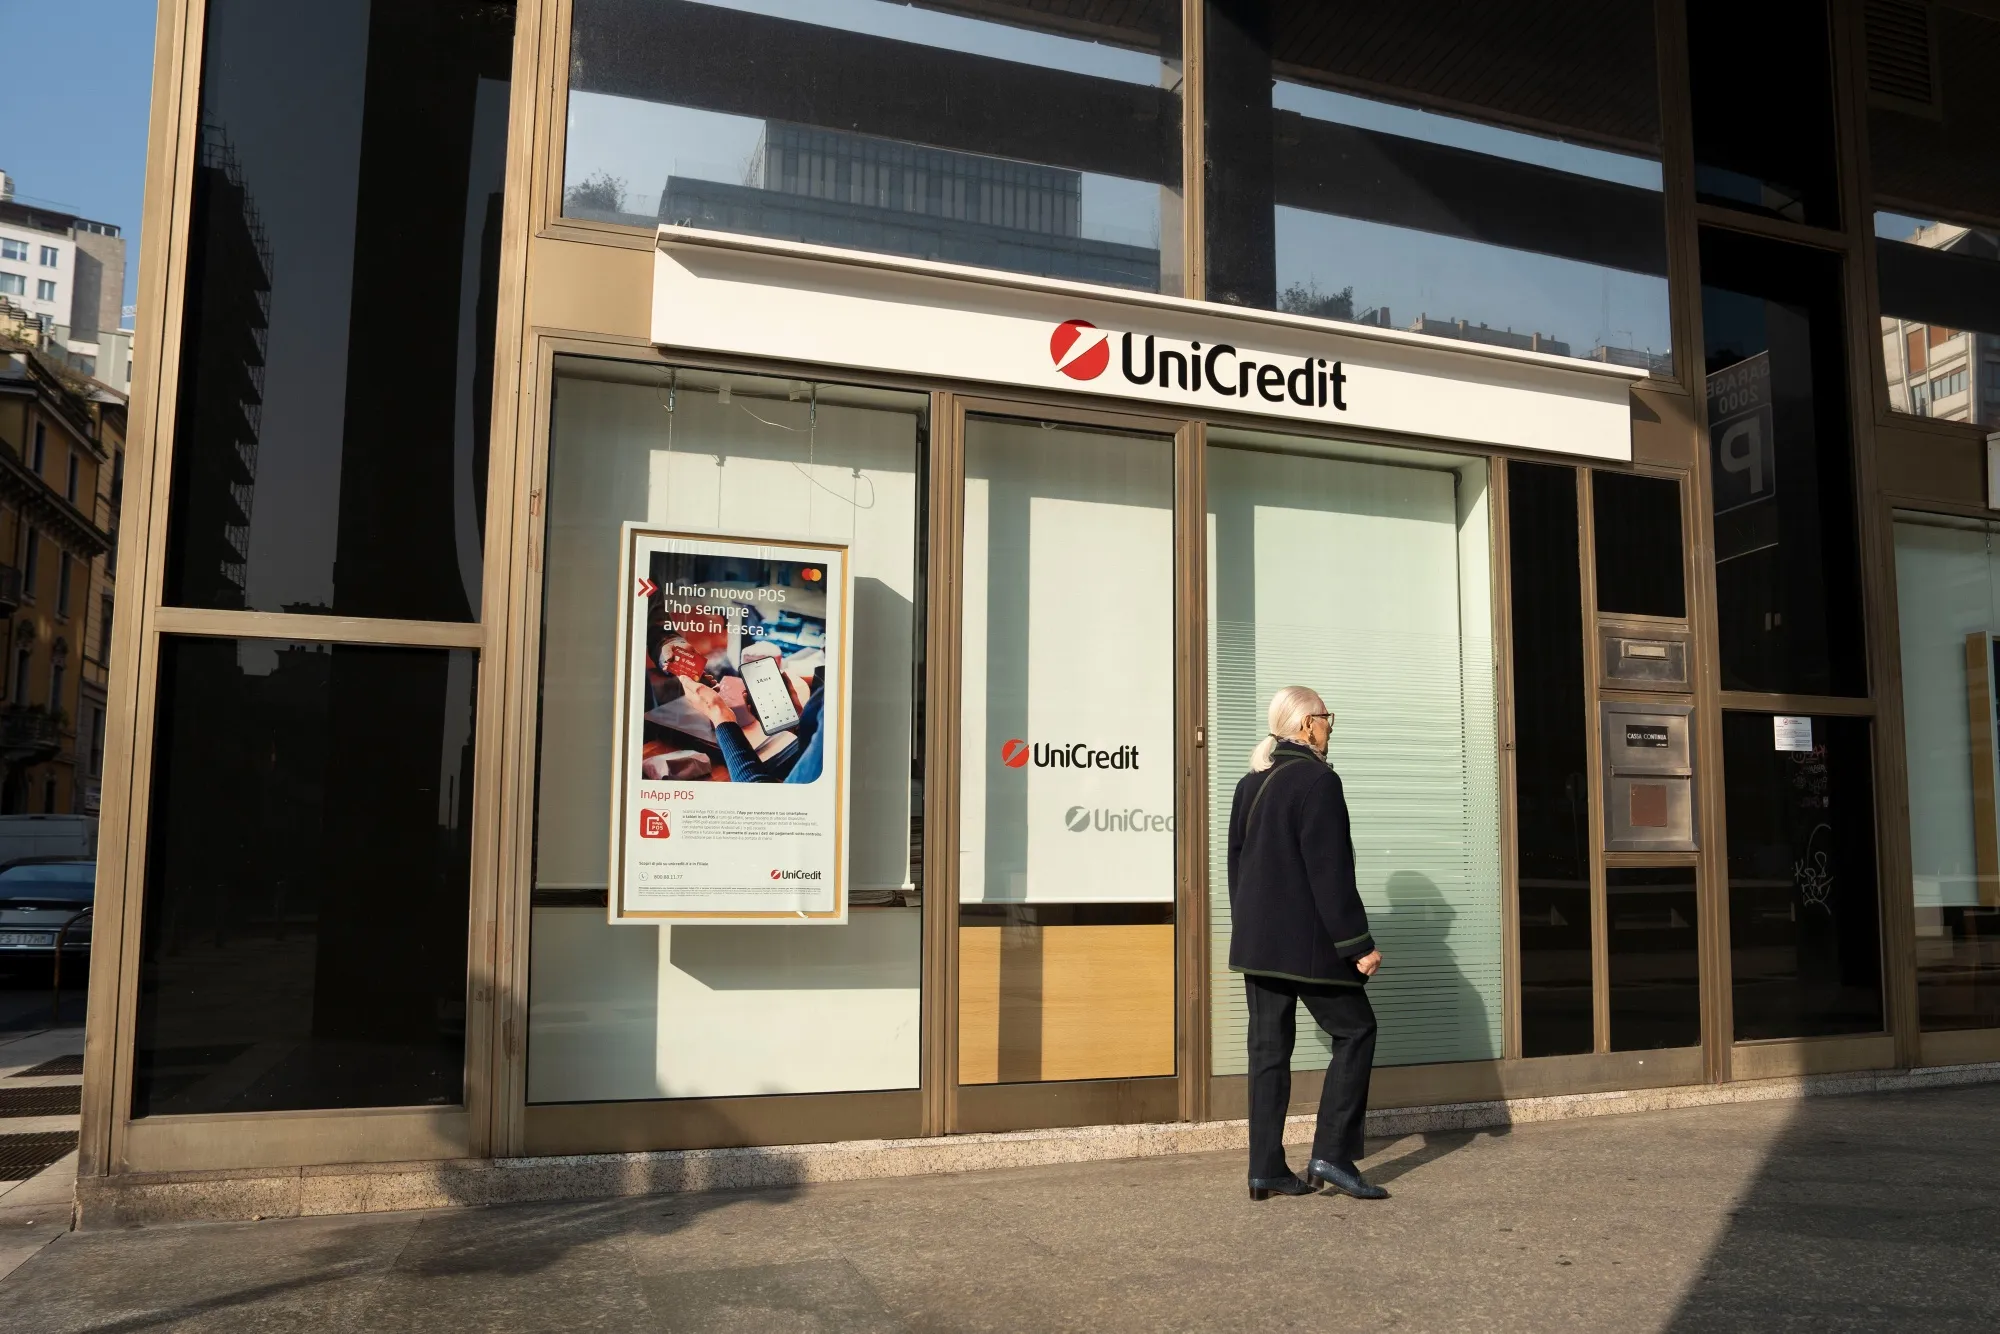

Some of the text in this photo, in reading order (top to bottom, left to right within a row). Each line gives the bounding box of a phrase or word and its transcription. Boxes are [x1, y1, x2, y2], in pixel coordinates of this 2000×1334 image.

[1122, 331, 1347, 411] UniCredit
[665, 582, 786, 603] Il mio nuovo POS
[695, 604, 749, 619] sempre
[663, 620, 768, 637] avuto in tasca.
[1034, 742, 1139, 770] UniCredit
[640, 789, 695, 802] InApp POS
[781, 869, 822, 880] UniCredit
